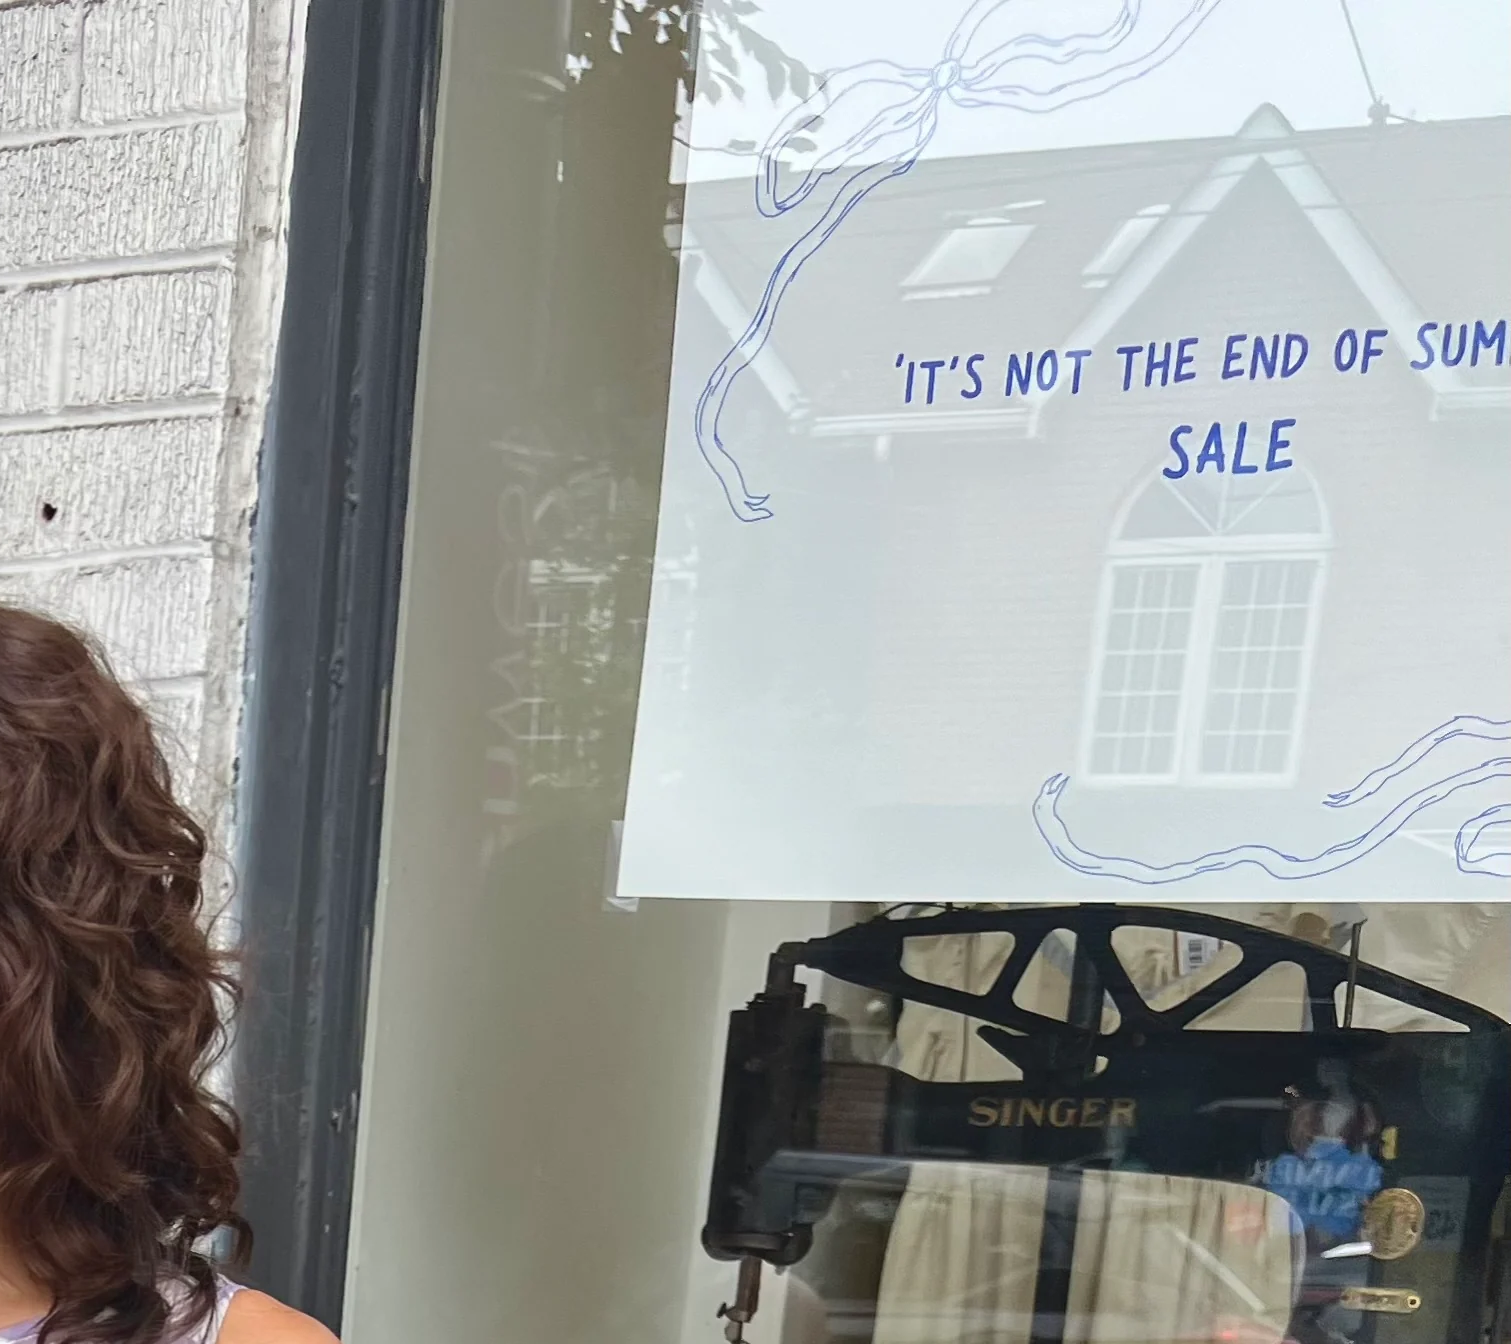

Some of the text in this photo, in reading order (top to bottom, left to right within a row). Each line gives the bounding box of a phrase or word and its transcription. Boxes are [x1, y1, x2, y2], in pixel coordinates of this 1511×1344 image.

[1006, 349, 1091, 397] NOT
[1116, 336, 1198, 389] THE
[1222, 331, 1309, 381] END
[1333, 328, 1388, 374] OF
[1409, 319, 1511, 371] SUM
[1163, 418, 1296, 480] SALE
[967, 1096, 1137, 1128] SINGER
